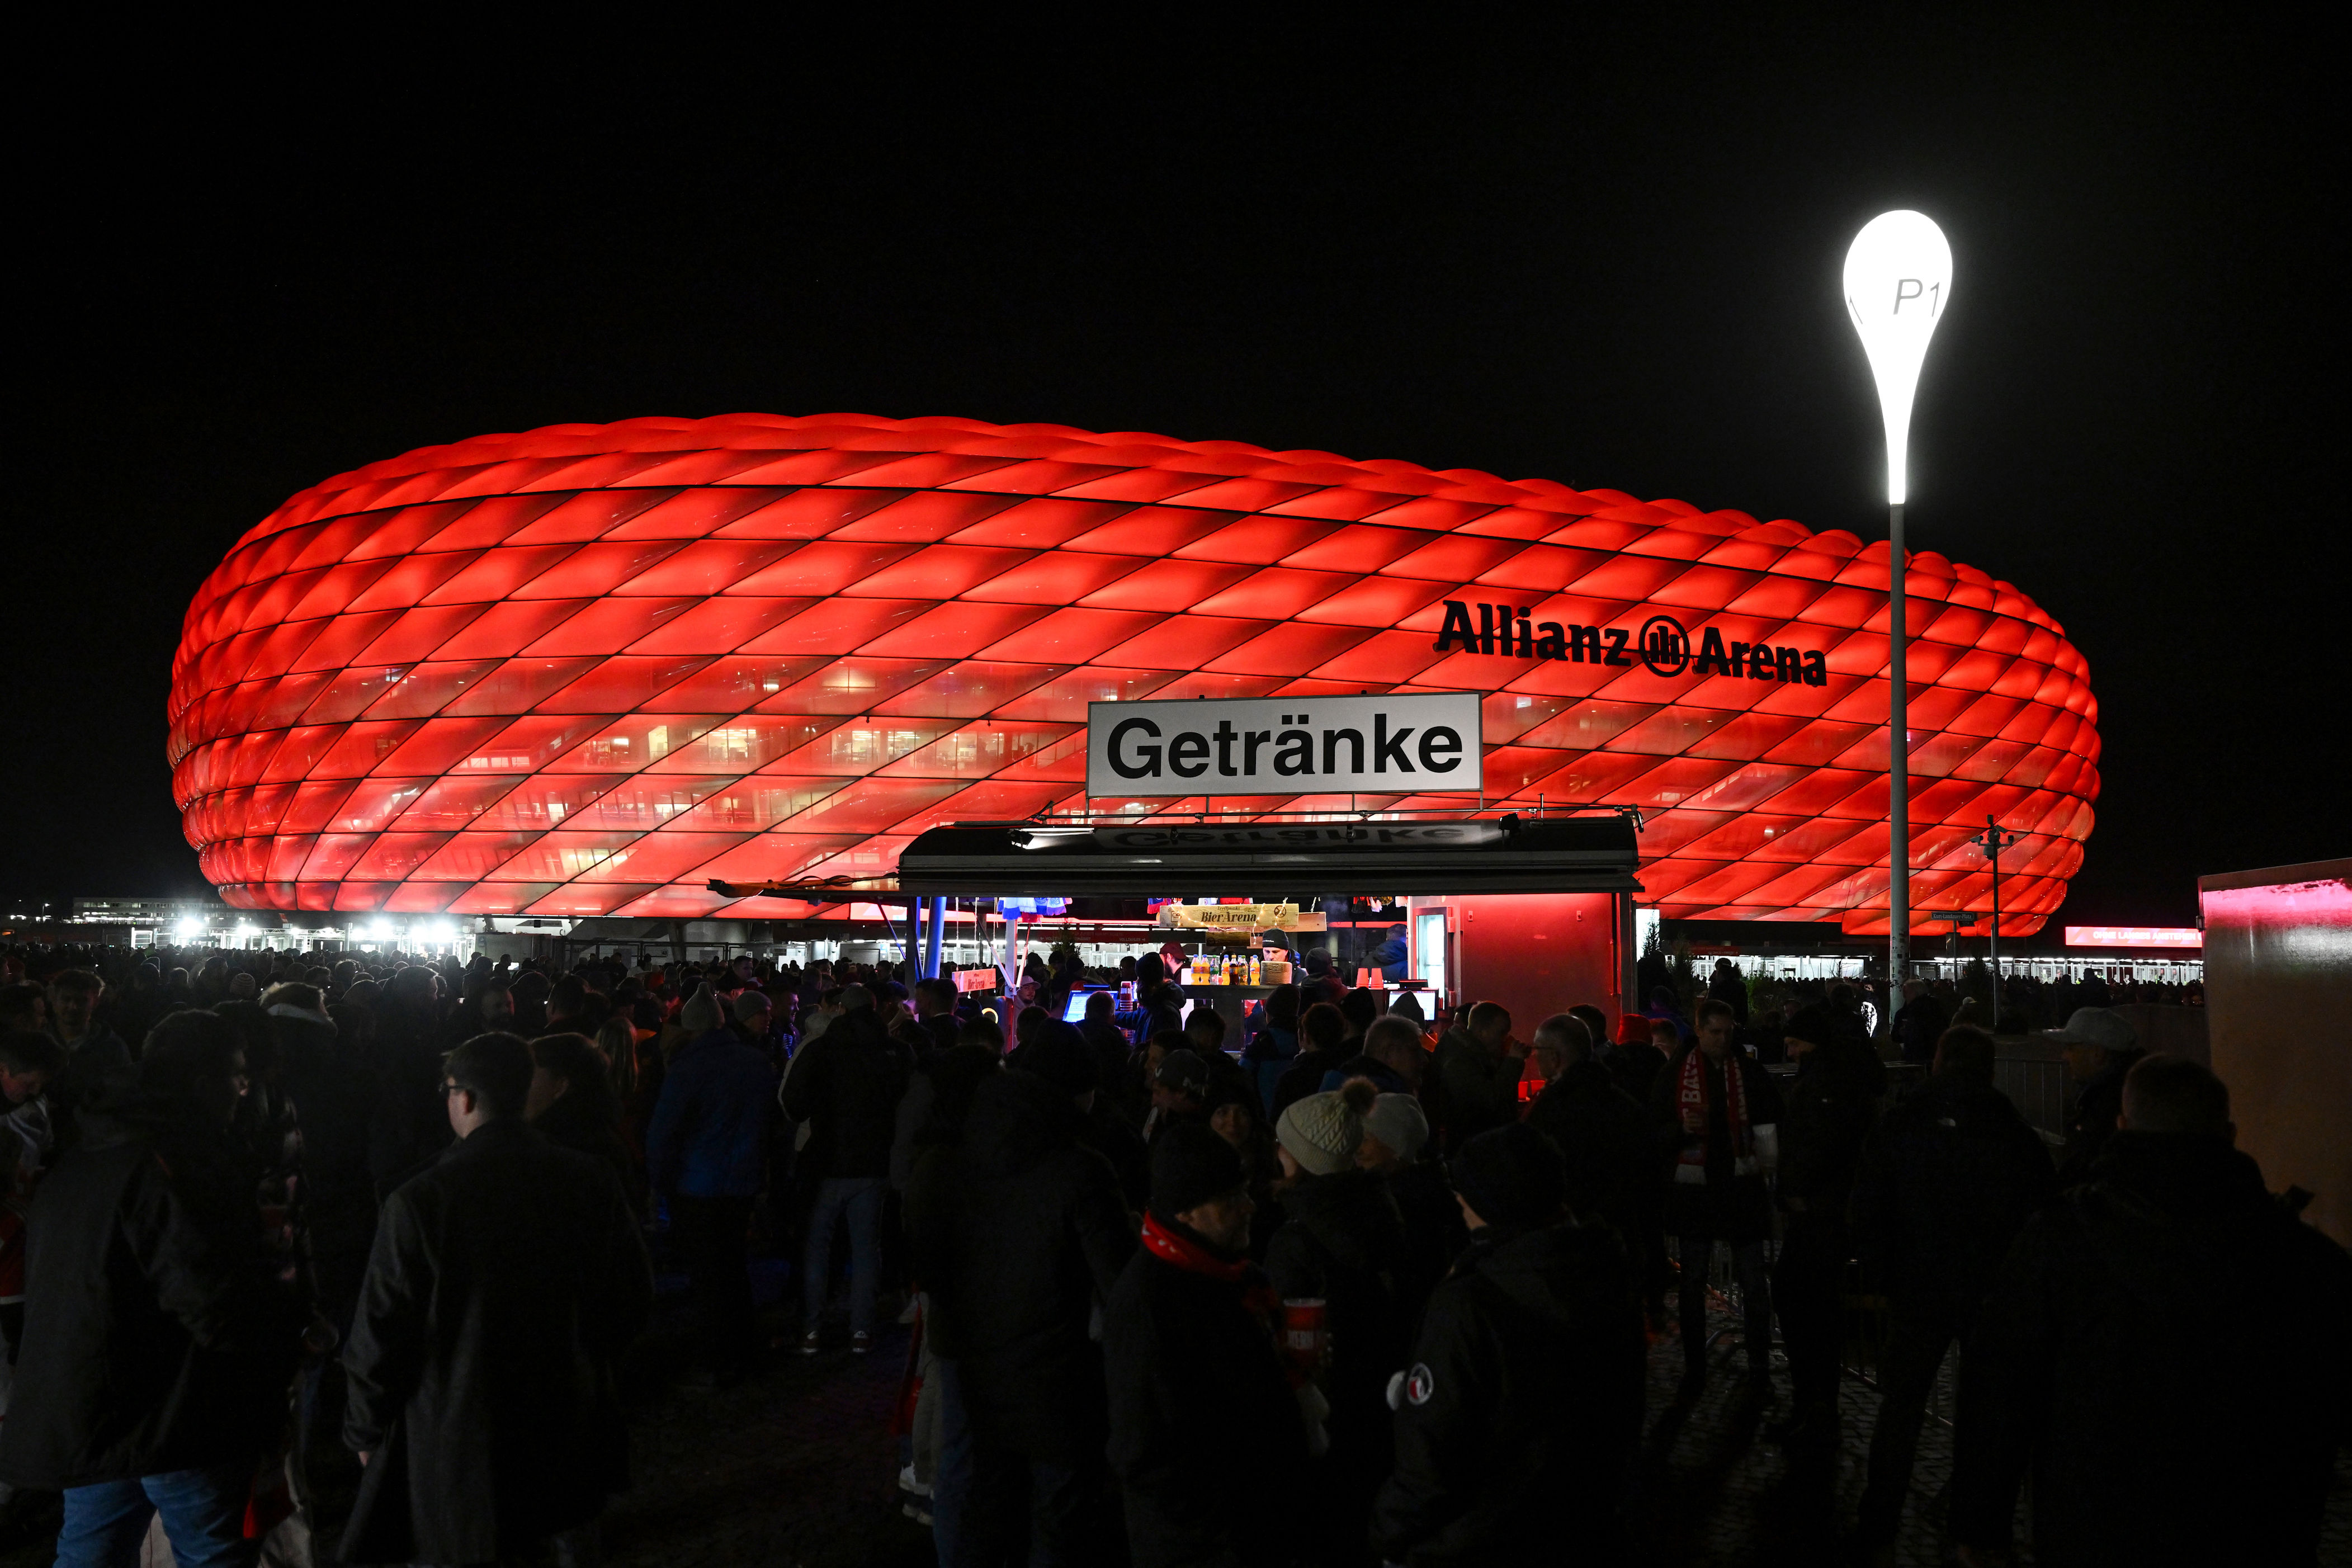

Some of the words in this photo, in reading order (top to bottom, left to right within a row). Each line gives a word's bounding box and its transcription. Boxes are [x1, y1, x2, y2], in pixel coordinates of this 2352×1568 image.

[1893, 278, 1940, 318] P1
[1438, 599, 1631, 667] Allianz
[1697, 627, 1827, 687] Arena
[1107, 713, 1463, 780] Getränke
[2093, 931, 2117, 939] OHNE
